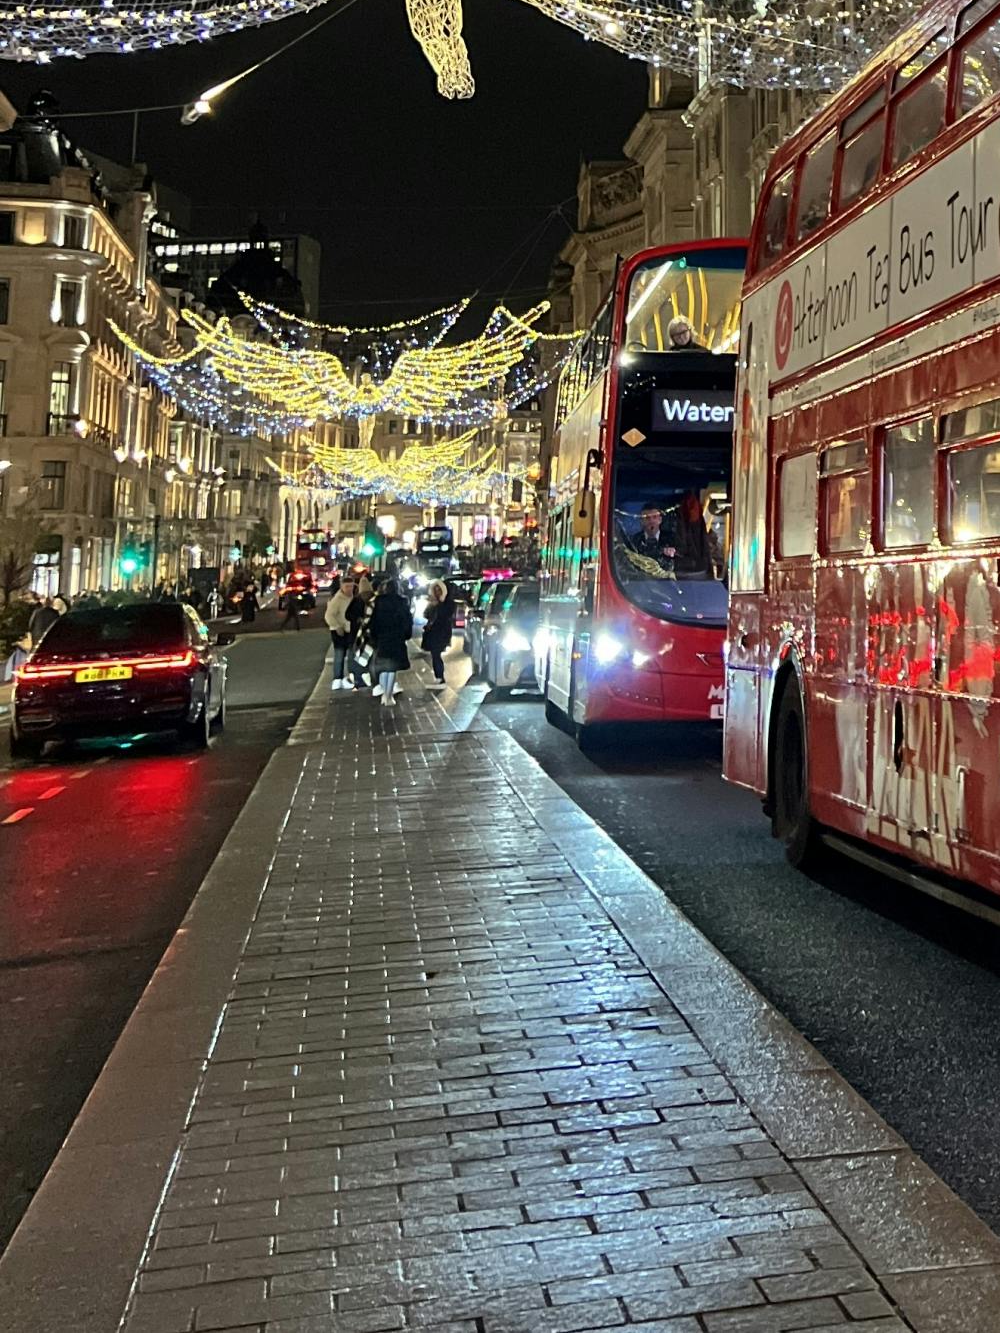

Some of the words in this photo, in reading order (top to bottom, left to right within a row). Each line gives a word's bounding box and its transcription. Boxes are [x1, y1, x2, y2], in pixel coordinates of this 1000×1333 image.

[793, 265, 858, 351] Afternoon
[867, 245, 890, 313] Tea
[899, 225, 935, 295] Bus
[947, 190, 994, 269] Tour
[662, 398, 735, 422] Water
